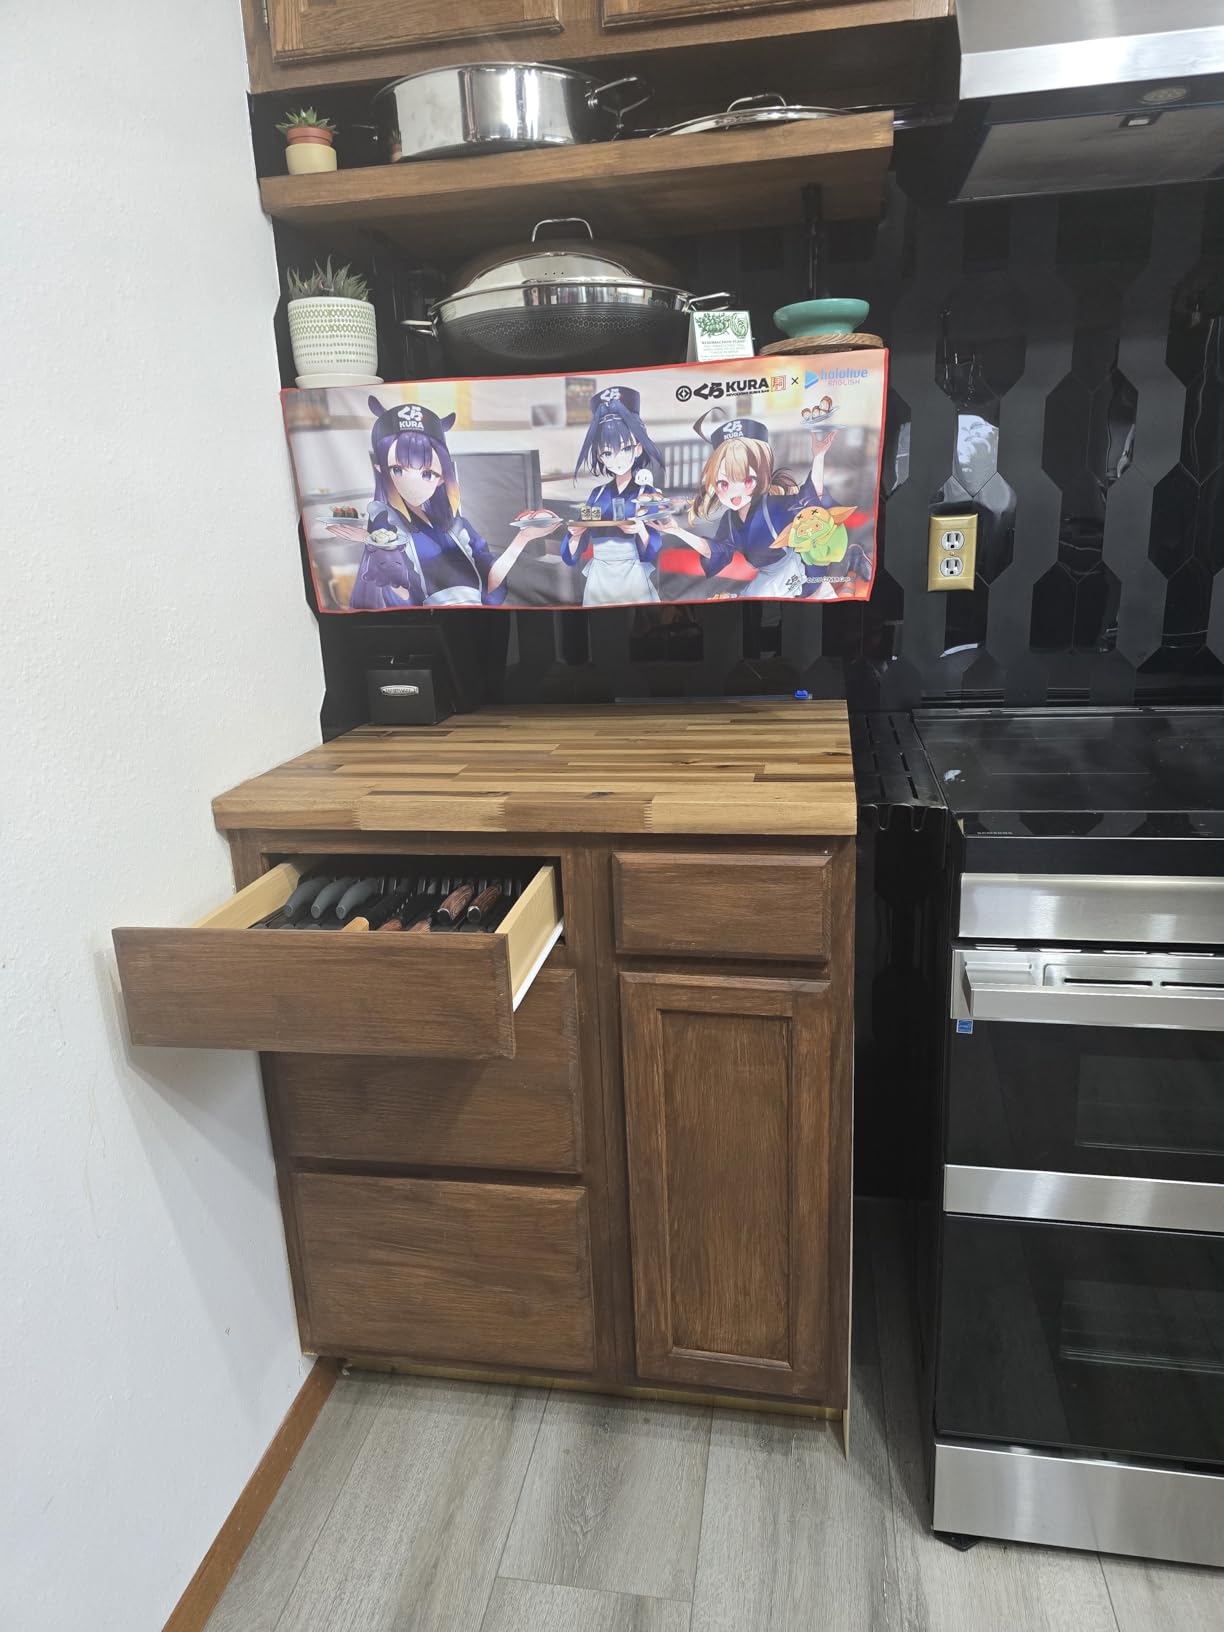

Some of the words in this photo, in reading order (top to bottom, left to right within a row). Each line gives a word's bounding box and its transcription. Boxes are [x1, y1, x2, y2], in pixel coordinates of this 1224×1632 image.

[821, 367, 868, 380] hololive
[828, 378, 861, 386] ENGLISH
[693, 382, 725, 400] くら
[726, 378, 769, 393] KURA
[397, 405, 424, 422] くら
[399, 421, 424, 429] KURA
[722, 420, 743, 433] くら
[723, 431, 744, 440] KURA
